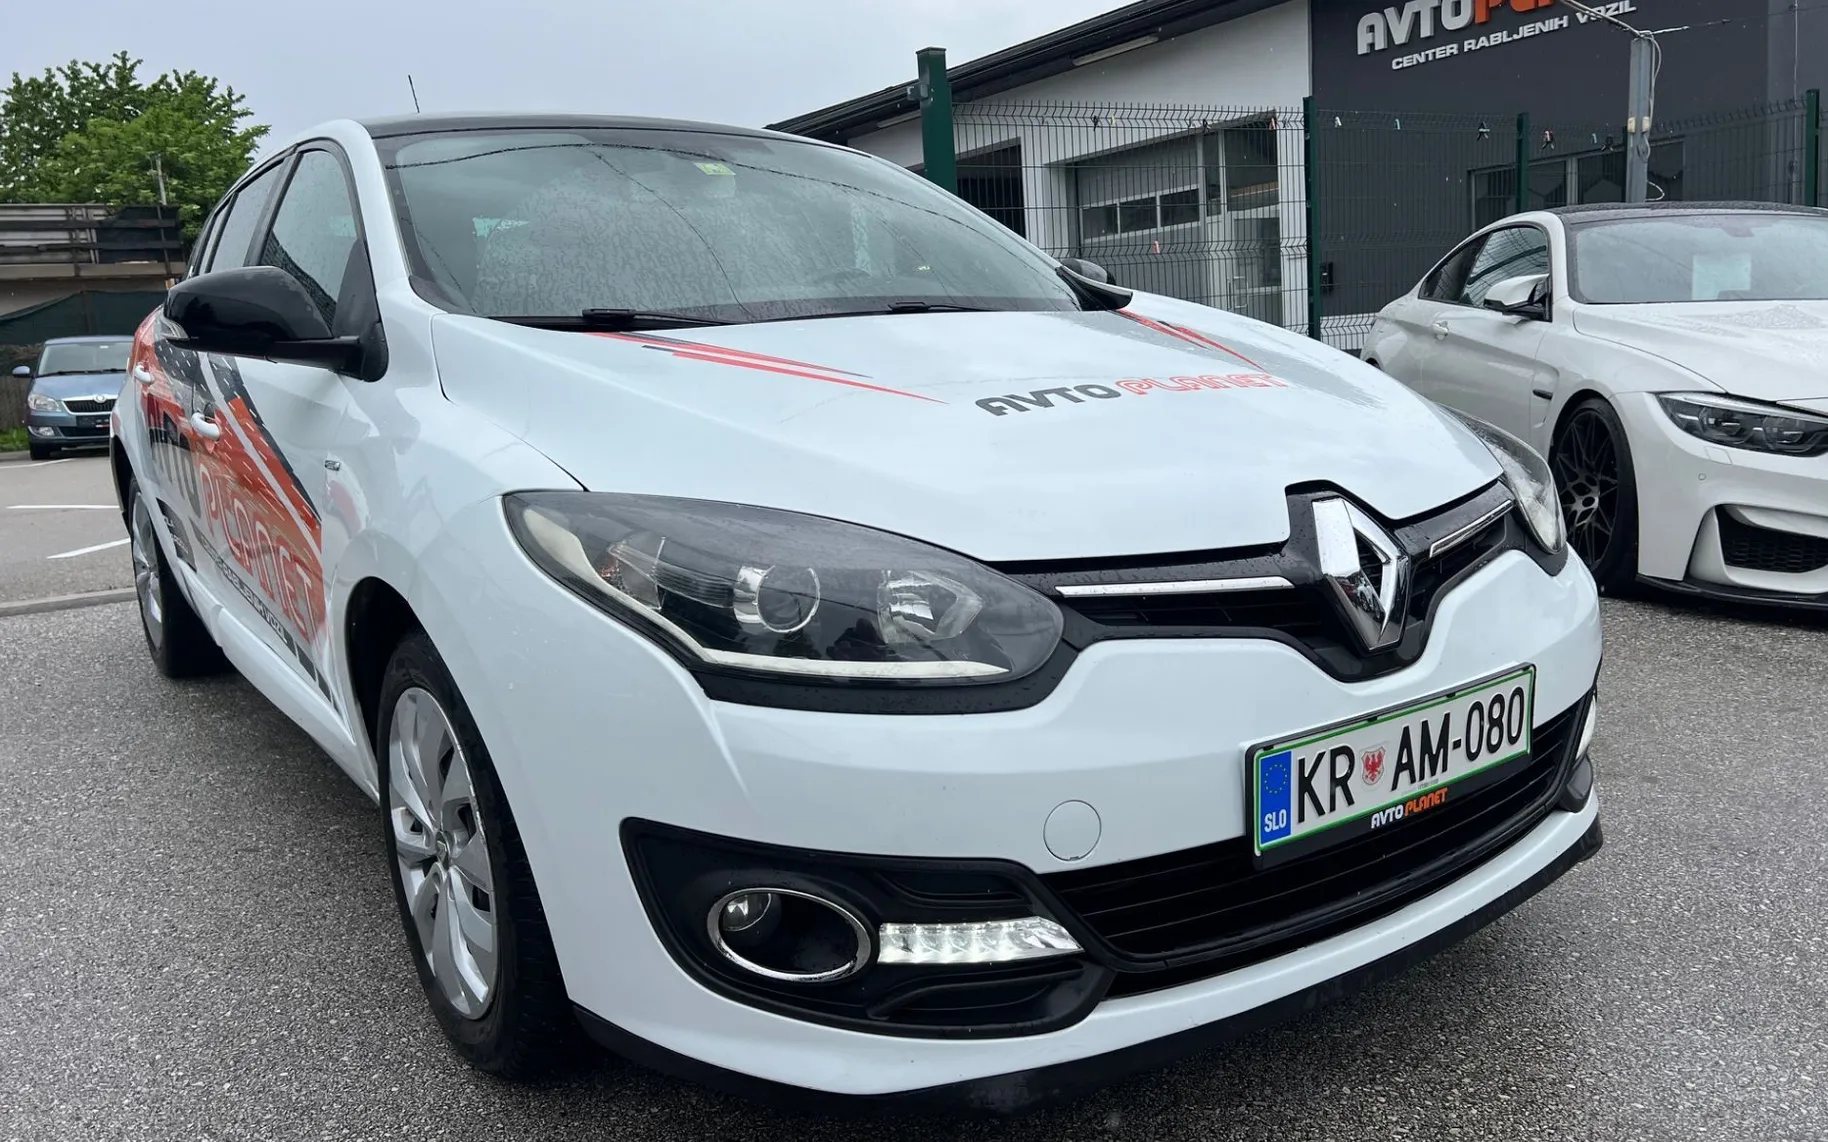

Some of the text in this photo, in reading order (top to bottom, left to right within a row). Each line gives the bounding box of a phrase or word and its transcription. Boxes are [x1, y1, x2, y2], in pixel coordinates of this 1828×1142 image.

[1391, 44, 1458, 70] CENTER
[1464, 15, 1570, 53] RABLJENIH
[975, 374, 1288, 416] AVTO PLANET
[199, 460, 319, 650] PLANET
[1297, 686, 1525, 825] KR AM-080
[1264, 809, 1287, 833] SLO
[1371, 787, 1448, 829] AVTO PLANET
